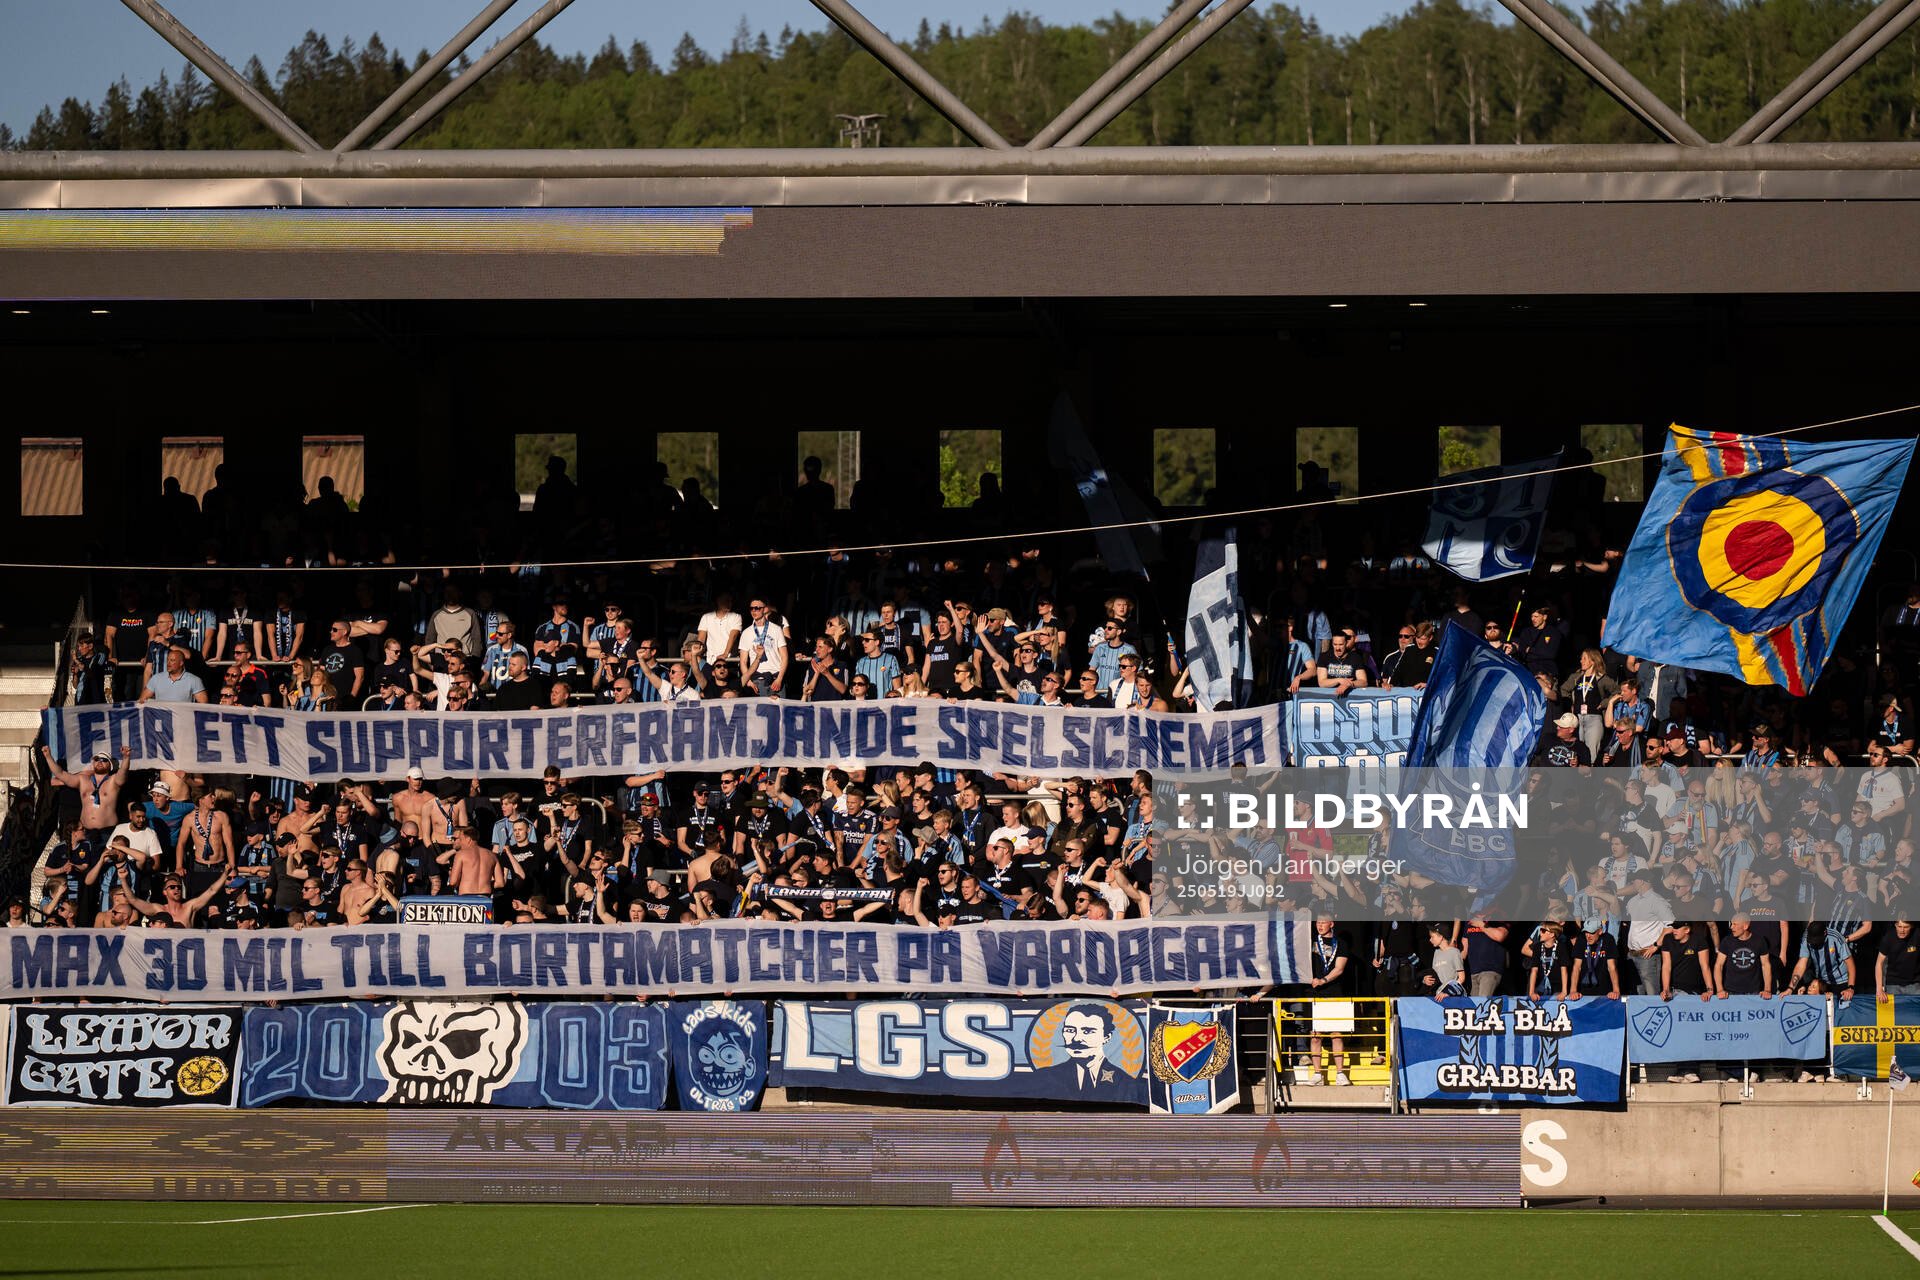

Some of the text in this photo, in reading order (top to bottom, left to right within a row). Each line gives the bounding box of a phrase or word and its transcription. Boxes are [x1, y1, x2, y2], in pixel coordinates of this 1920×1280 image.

[1300, 697, 1424, 742] DJU
[78, 700, 1266, 773] FÖR ETT SUPPORTERFRÄMJANDE SPELSCHEMA
[405, 904, 485, 923] SEKTION
[1750, 907, 1776, 917] Diffen
[11, 934, 126, 988] MAX
[144, 937, 207, 989] 30
[223, 937, 322, 993] MIL
[331, 933, 445, 988] TILL
[464, 928, 880, 988] BORTAMATCHER
[977, 924, 1260, 986] VARDAGAR
[1444, 1004, 1572, 1031] BLÅ BLÅ
[1645, 1009, 1667, 1037] D.I.F.
[1678, 1009, 1775, 1022] FAR OCH SON
[1785, 1012, 1816, 1029] D.I.F.
[26, 1014, 232, 1054] LEMON
[1172, 1030, 1214, 1062] D.I.F.
[1705, 1033, 1750, 1041] EST. 1999
[242, 1003, 668, 1109] 20 03
[21, 1055, 174, 1099] GATE
[1437, 1065, 1576, 1091] GRABBAR
[690, 1087, 734, 1111] ULTRAS
[1521, 1119, 1567, 1187] S
